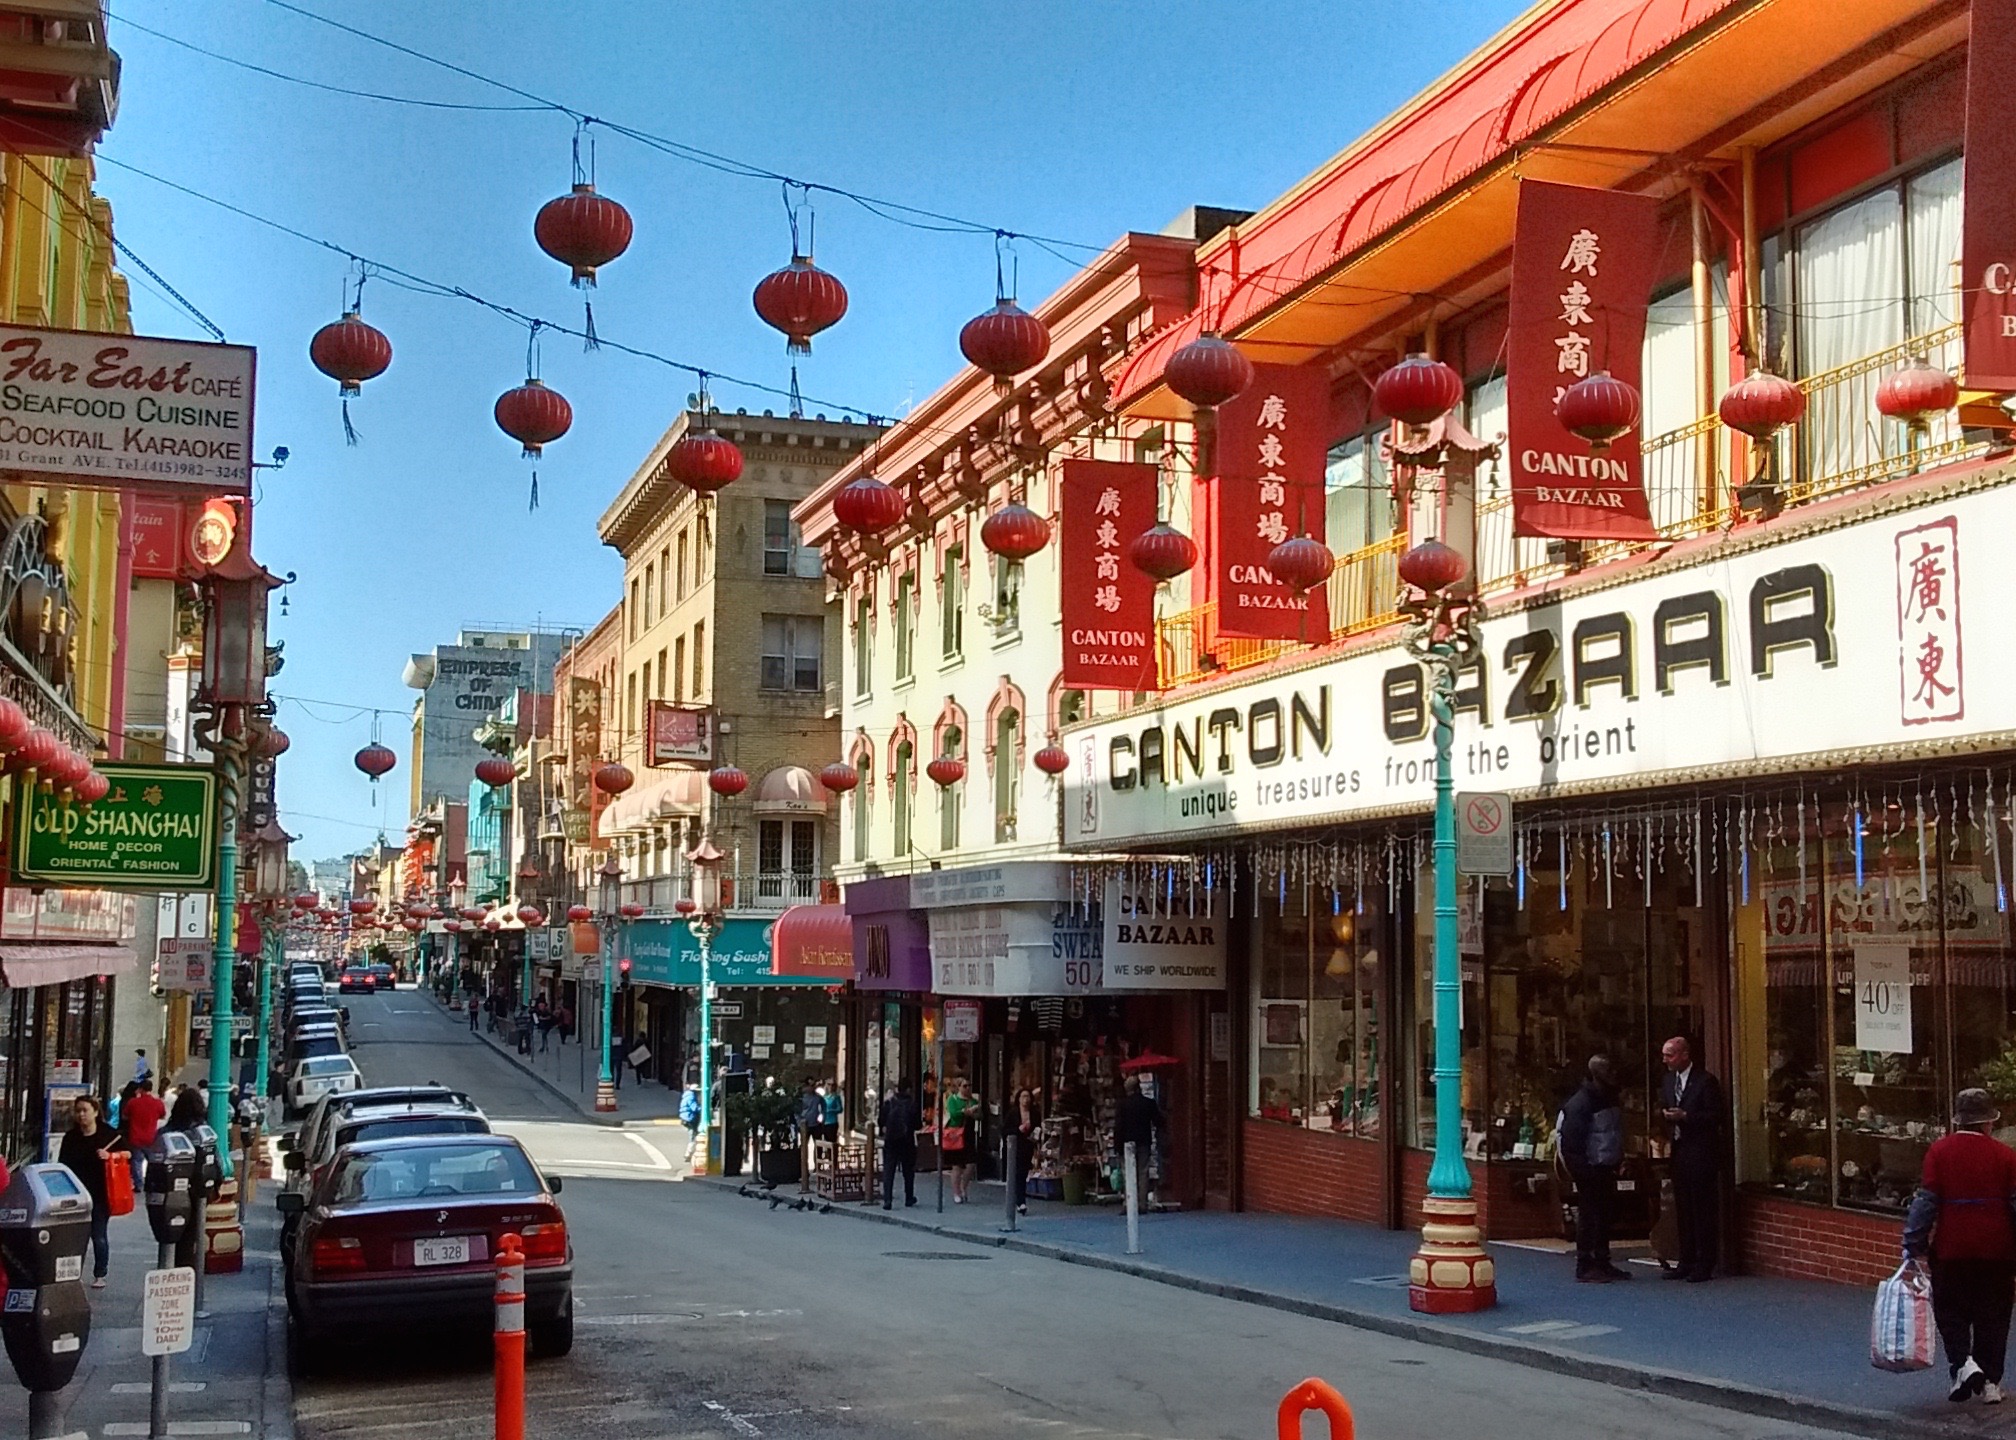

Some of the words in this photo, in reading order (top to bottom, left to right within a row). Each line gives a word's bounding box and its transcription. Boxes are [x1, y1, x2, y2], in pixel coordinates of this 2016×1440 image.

[1553, 229, 1601, 416] 廣東商
[1, 337, 78, 383] Far
[87, 346, 192, 393] East
[192, 376, 242, 399] CAFÉ
[2, 385, 125, 419] SEAFOOD
[137, 397, 240, 429] CUISINE
[0, 417, 113, 451] COCKTAIL
[123, 427, 242, 460] KARAOKE
[19, 451, 64, 466] Grant
[73, 455, 111, 469] AVE.
[1521, 449, 1630, 483] CANTON
[1536, 485, 1626, 509] BAZAAR
[1094, 486, 1123, 613] 廣東商場
[1238, 594, 1310, 612] BAZAAR
[1904, 540, 1956, 711] 廣東
[1071, 629, 1146, 648] CANTON
[439, 659, 521, 677] EMPRESS
[1079, 653, 1139, 668] BAZAAR
[470, 678, 493, 692] OF
[1109, 684, 1332, 792] CANTON
[1382, 562, 1840, 745] BAZAAR
[455, 694, 504, 710] CHINA
[1181, 787, 1238, 818] unique
[1256, 767, 1361, 806] treasures
[1384, 756, 1438, 788] from
[1468, 743, 1510, 774] the
[1539, 718, 1637, 765] orient
[34, 807, 79, 834] OLD
[85, 810, 201, 838] SHANGHAI
[69, 841, 108, 851] HOME
[116, 842, 163, 852] DECOR
[110, 851, 120, 860] &
[50, 857, 115, 869] ORIENTAL
[123, 860, 180, 871] FASHION
[1121, 895, 1215, 916] CANTON
[1117, 925, 1215, 945] BAZAAR
[161, 940, 177, 952] NO
[732, 950, 770, 965] Sushi
[726, 967, 744, 976] Tel:
[1114, 965, 1129, 975] WE
[1134, 965, 1155, 975] SHIP
[1160, 966, 1217, 976] WORLDWIDE
[1862, 980, 1890, 1014] 40
[424, 1247, 437, 1261] RL
[442, 1246, 462, 1260] 328
[149, 1275, 160, 1285] NO
[149, 1285, 191, 1297] PASSENGER
[161, 1299, 179, 1310] ZONE
[156, 1334, 180, 1344] DAILY
